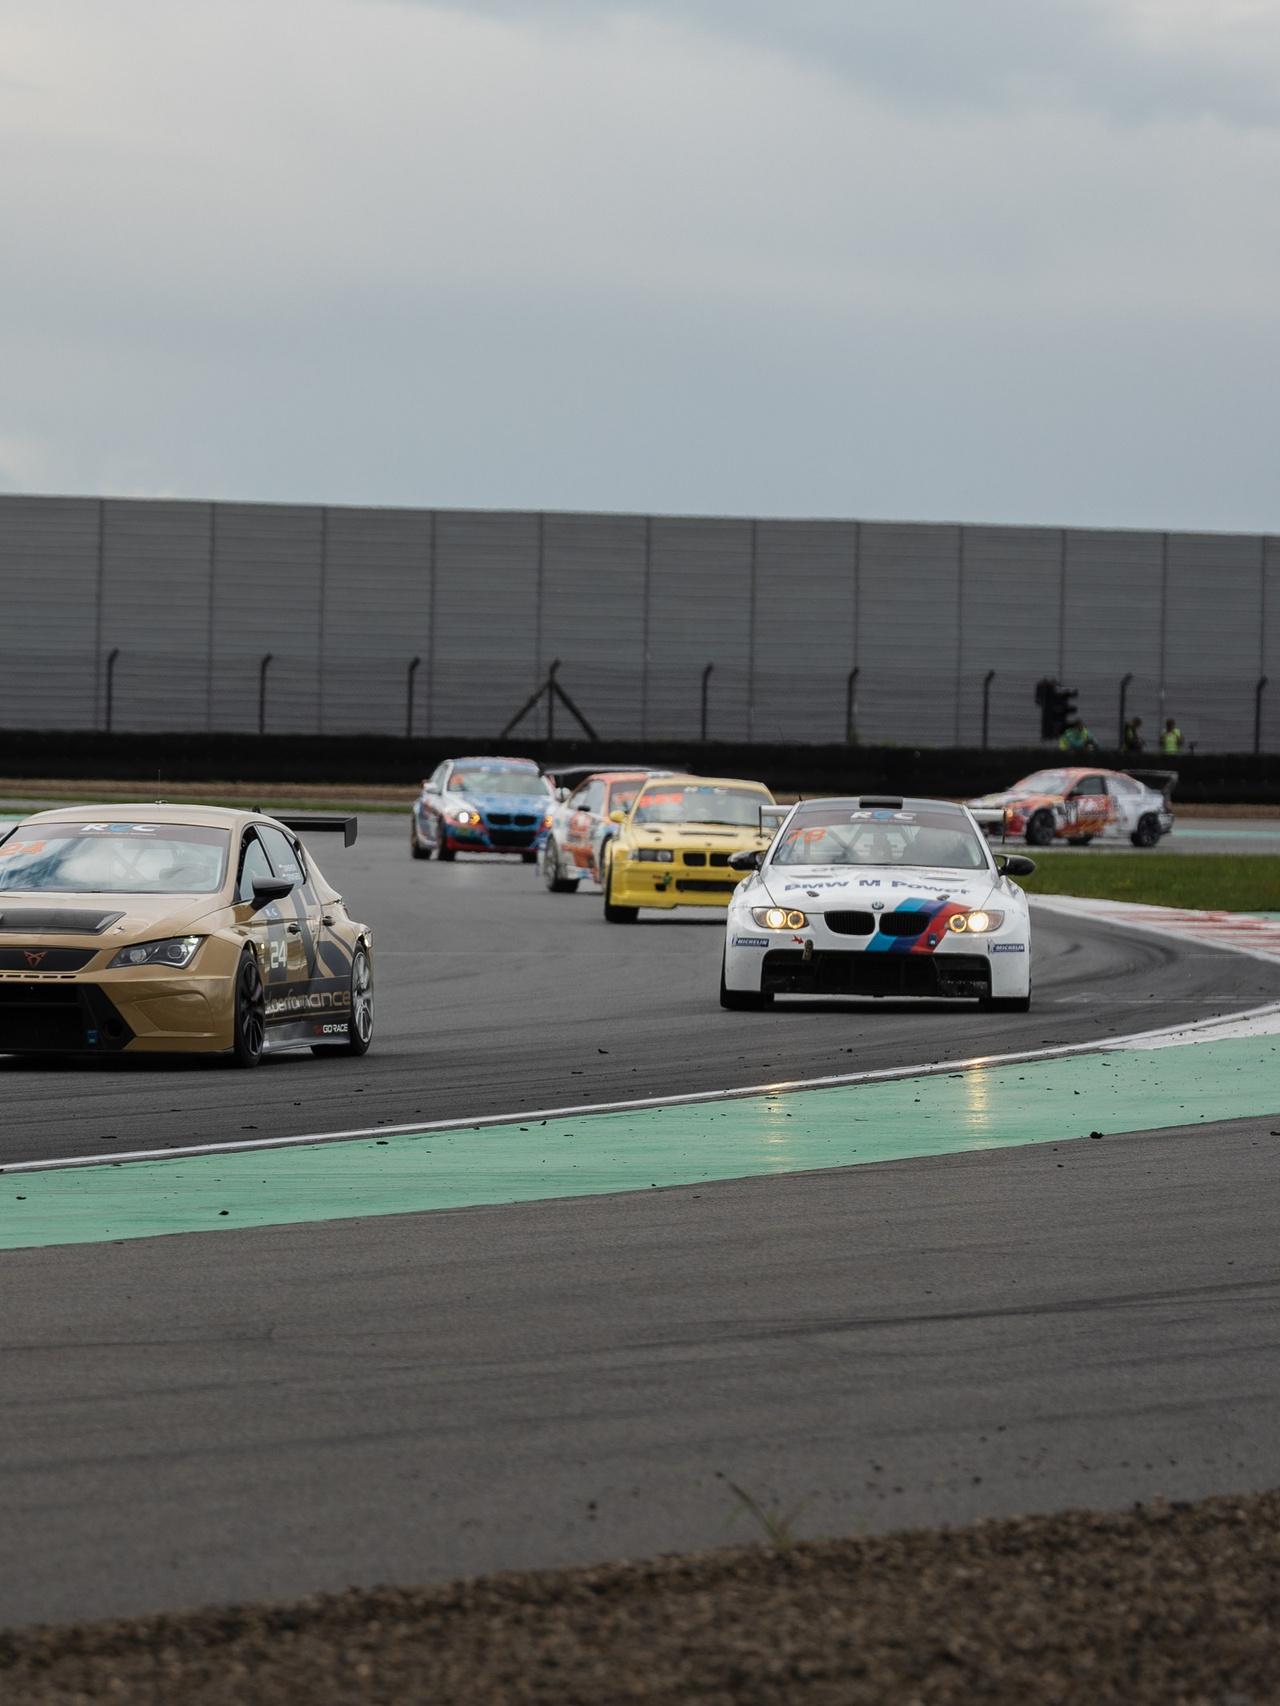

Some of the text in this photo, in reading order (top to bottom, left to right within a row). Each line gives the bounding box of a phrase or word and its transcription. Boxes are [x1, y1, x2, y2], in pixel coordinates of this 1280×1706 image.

[786, 829, 827, 845] 78
[784, 879, 971, 895] BMW M Power
[270, 940, 287, 969] 24
[333, 1023, 349, 1033] RACE
